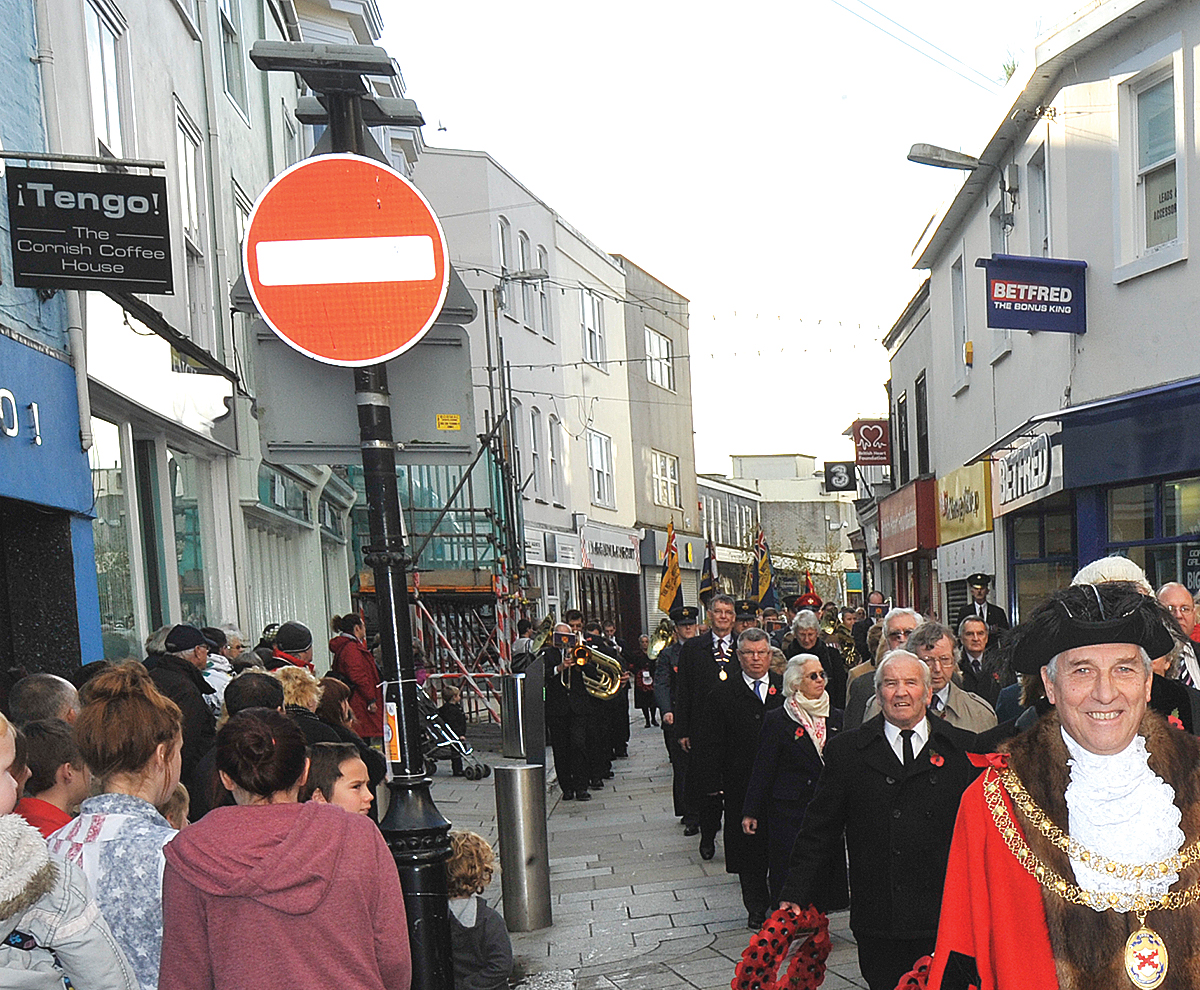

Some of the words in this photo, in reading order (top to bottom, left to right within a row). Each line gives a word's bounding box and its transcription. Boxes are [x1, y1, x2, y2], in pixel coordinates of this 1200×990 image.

[1158, 189, 1173, 204] LEADS
[72, 226, 110, 240] The
[17, 239, 92, 256] Cornish
[99, 244, 165, 260] Coffee
[61, 259, 125, 274] House
[993, 282, 1073, 303] BETFRED
[993, 301, 1012, 310] THE
[1014, 302, 1048, 312] BONUS
[1049, 305, 1072, 314] KING
[830, 464, 850, 488] 3
